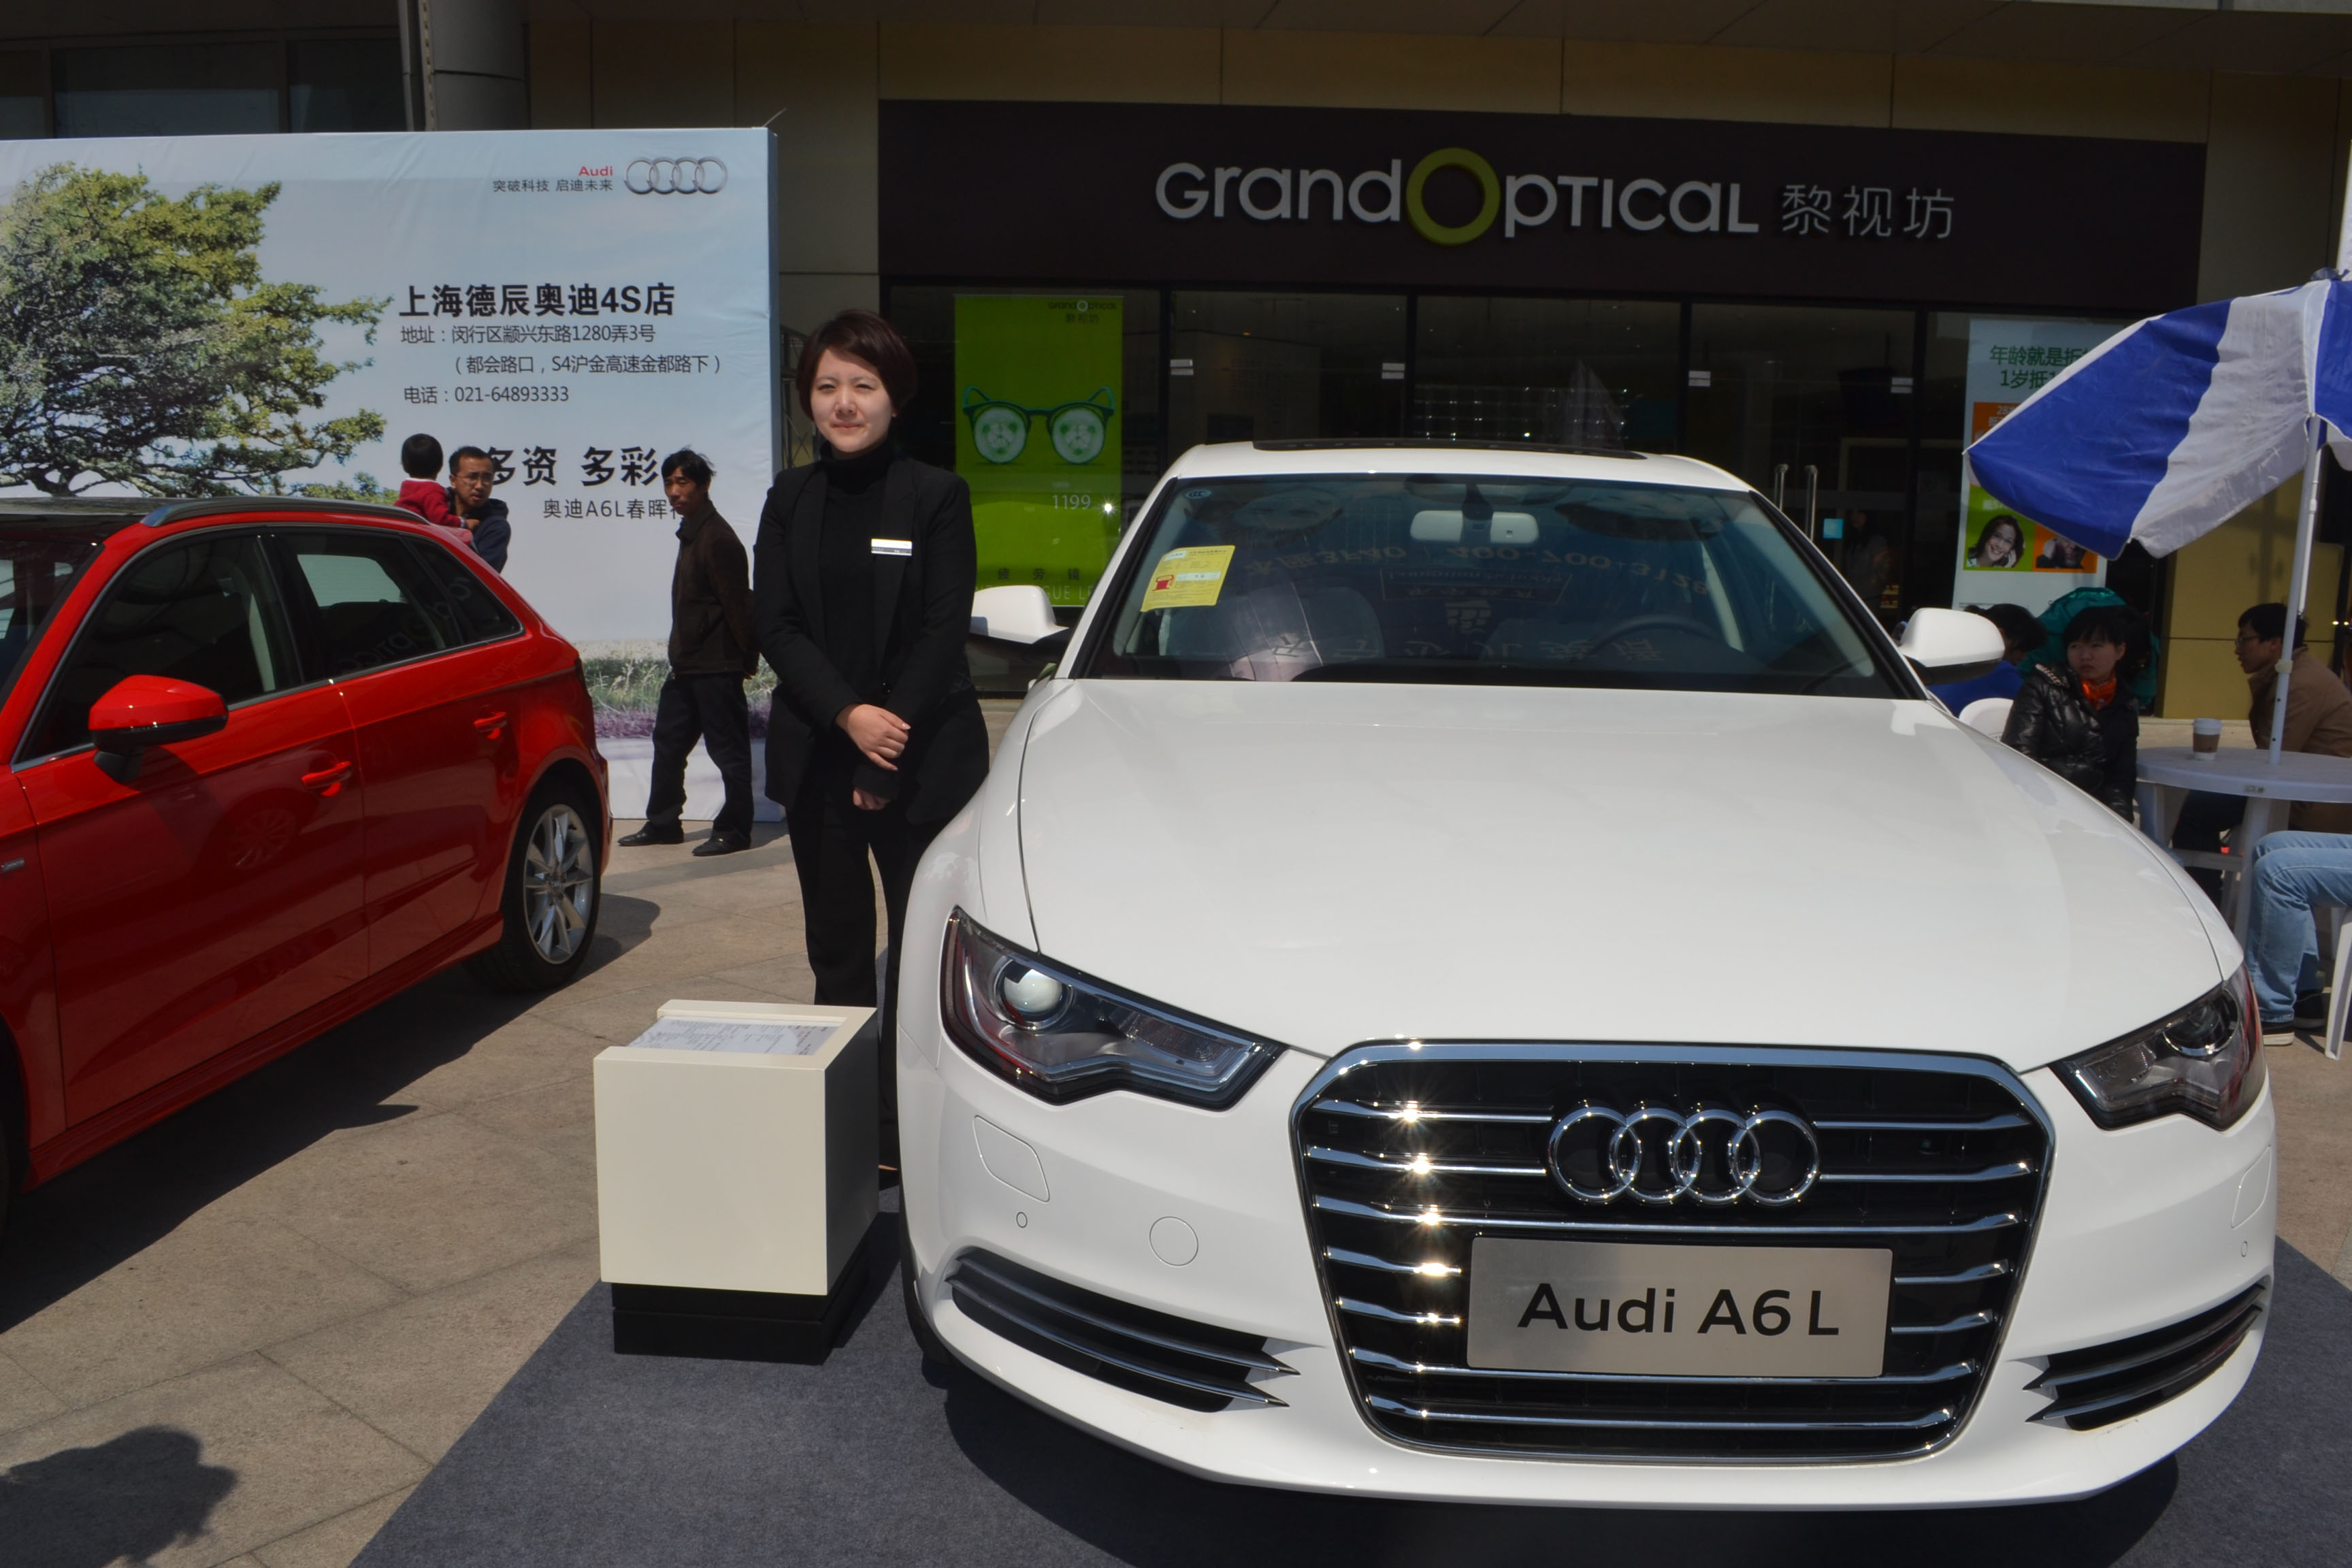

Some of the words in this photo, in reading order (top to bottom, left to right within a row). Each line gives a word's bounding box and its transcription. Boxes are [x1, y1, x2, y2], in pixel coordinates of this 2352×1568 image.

[578, 165, 613, 177] Audi
[492, 179, 550, 193] 突破科技
[555, 179, 613, 193] 启迪未来
[1781, 184, 1955, 240] 黎视坊
[399, 282, 675, 318] 上海德辰奥迪4S店
[1989, 345, 2088, 367] 年龄就是折
[1052, 494, 1092, 510] 1199
[1516, 1282, 1676, 1334] Audi
